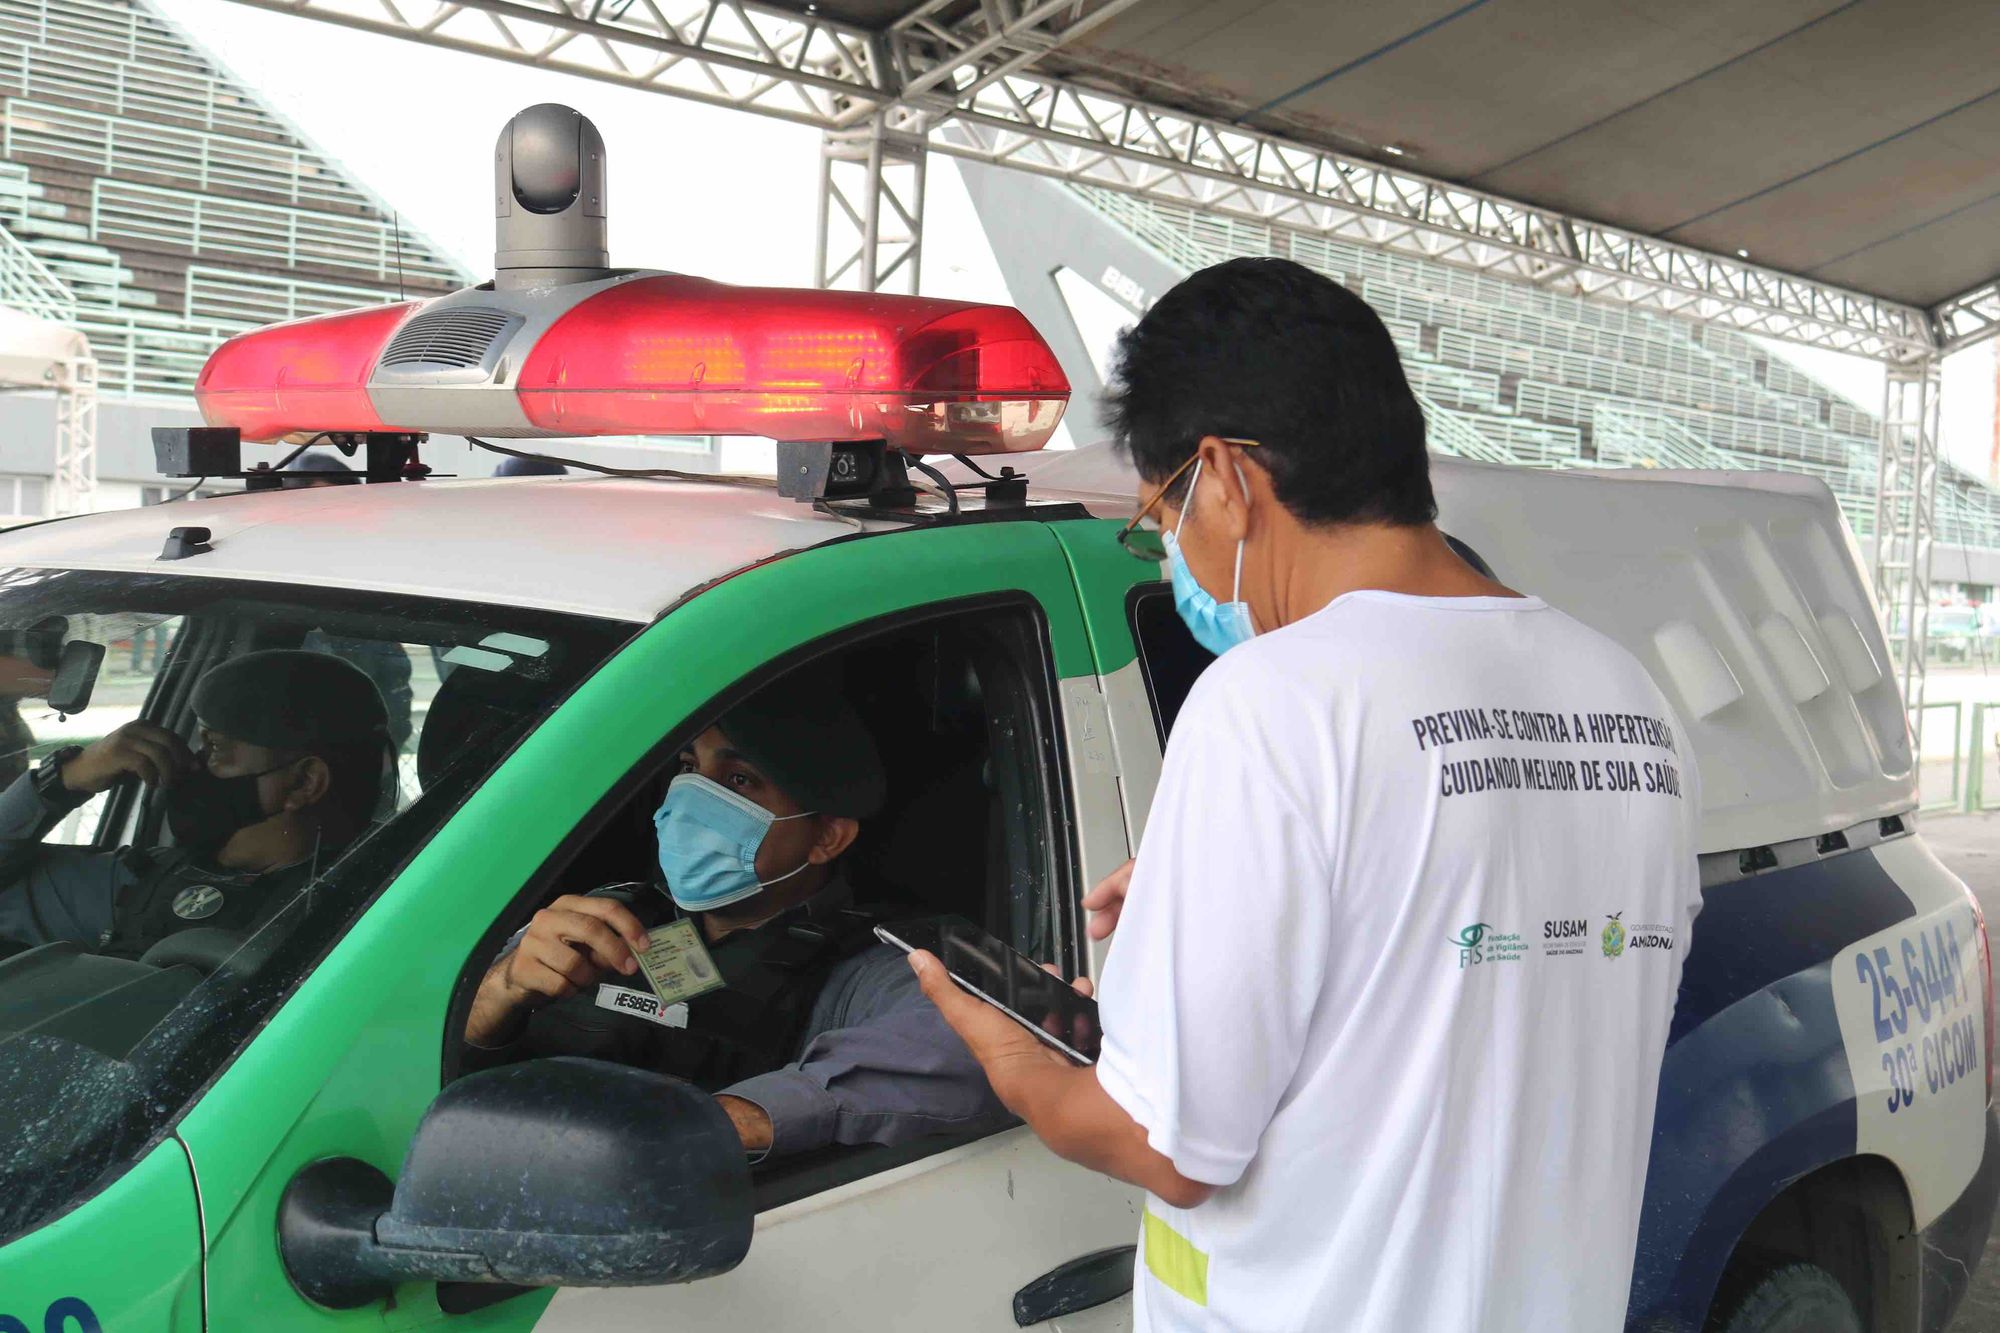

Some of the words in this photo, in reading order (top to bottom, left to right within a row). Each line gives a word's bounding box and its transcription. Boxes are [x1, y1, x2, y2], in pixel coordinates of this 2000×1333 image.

[1412, 708, 1514, 750] PREVINA-SE
[1512, 710, 1571, 743] CONTRA
[1573, 713, 1586, 743] A
[1587, 713, 1677, 756] HIPERTENSÃ
[1441, 757, 1521, 797] CUIDANDO
[1521, 758, 1579, 791] MELHOR
[1582, 760, 1603, 791] DE
[1606, 761, 1641, 792] SUA
[1544, 919, 1587, 939] SUSAM
[614, 992, 659, 1016] HESBER
[1922, 1013, 1977, 1095] CICOM
